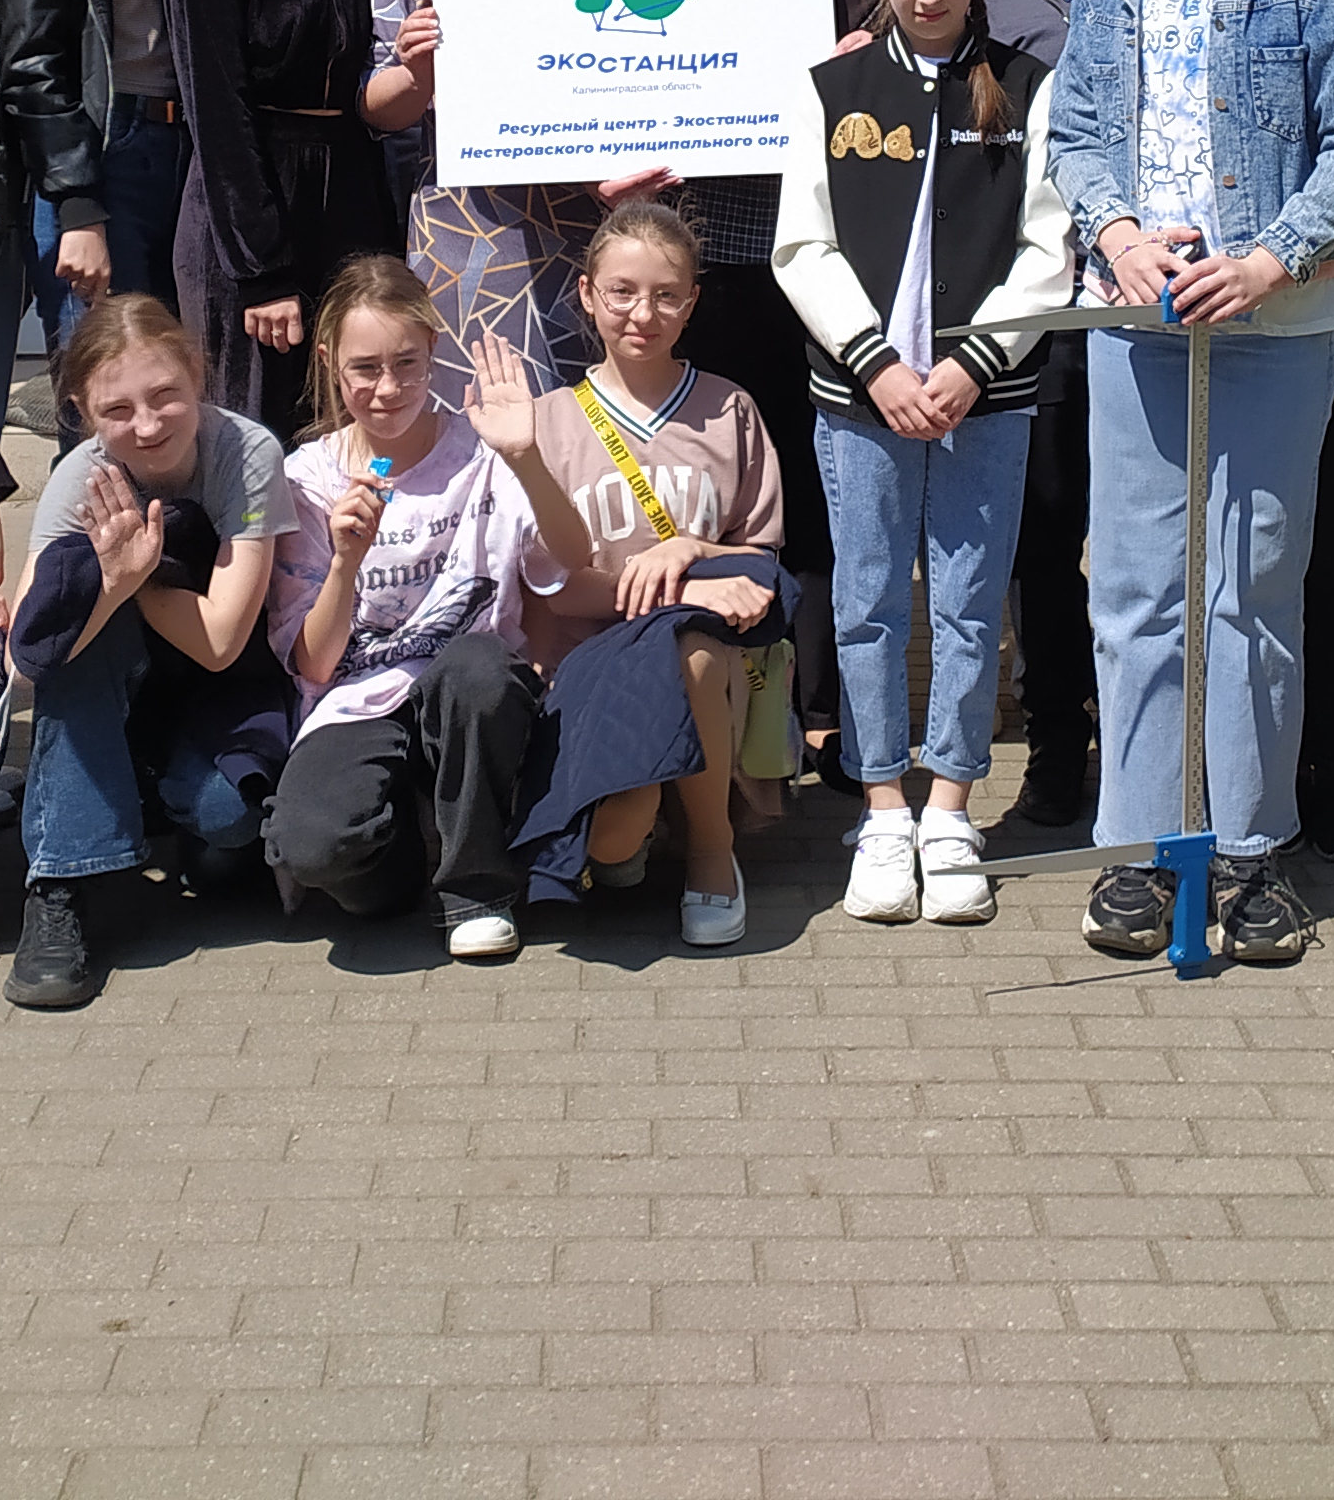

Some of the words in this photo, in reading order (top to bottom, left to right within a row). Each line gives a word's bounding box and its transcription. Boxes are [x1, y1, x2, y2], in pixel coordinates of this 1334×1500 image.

[536, 51, 739, 74] ЭКОСТАНЦИЯ
[572, 82, 659, 96] Калининградская
[661, 81, 702, 92] область
[498, 117, 599, 137] Ресурсный
[604, 117, 657, 134] центр
[673, 112, 780, 129] Экостанция
[460, 141, 595, 161] Нестеровского
[599, 134, 754, 155] муниципального
[758, 133, 789, 148] окр
[584, 400, 610, 433] LOVE
[627, 472, 653, 508] LOVE
[355, 544, 461, 593] anges
